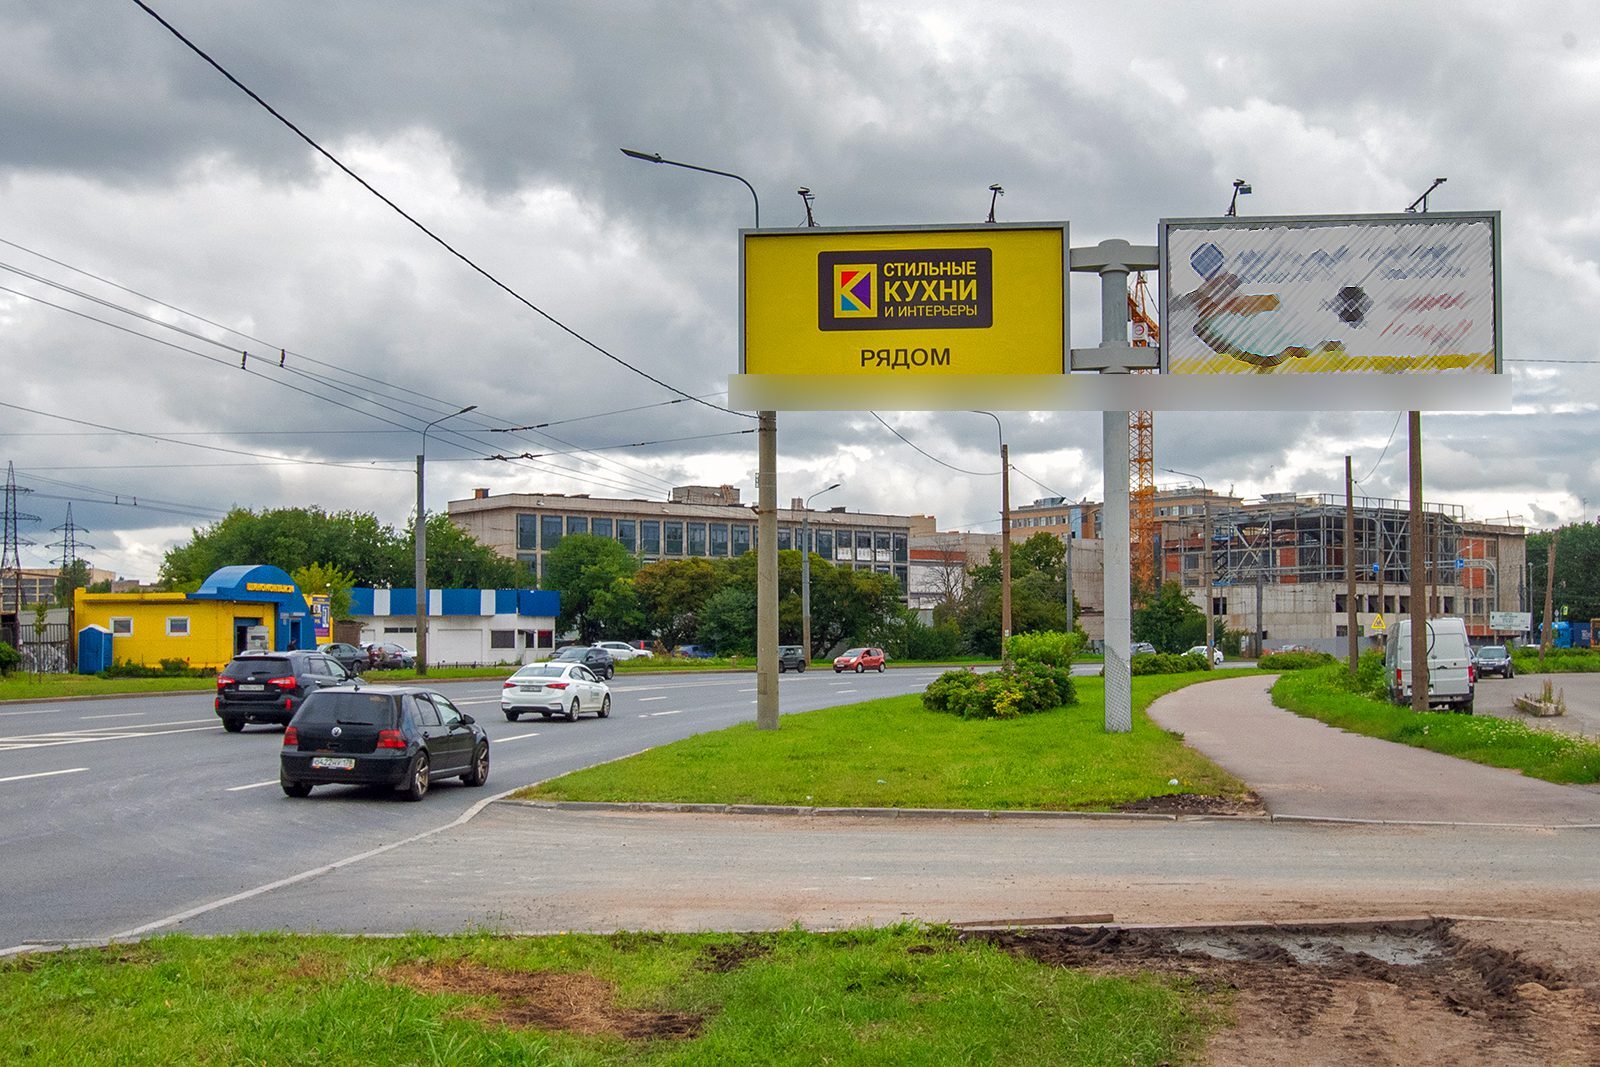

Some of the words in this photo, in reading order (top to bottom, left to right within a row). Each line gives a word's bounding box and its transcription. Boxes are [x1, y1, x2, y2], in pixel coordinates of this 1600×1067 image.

[883, 261, 977, 277] СТИЛЬНЫЕ
[884, 279, 977, 302] КУХНИ
[884, 306, 894, 318] И
[898, 304, 978, 317] ИНТЕРЬЕРЫ
[861, 348, 950, 370] РЯДОМ
